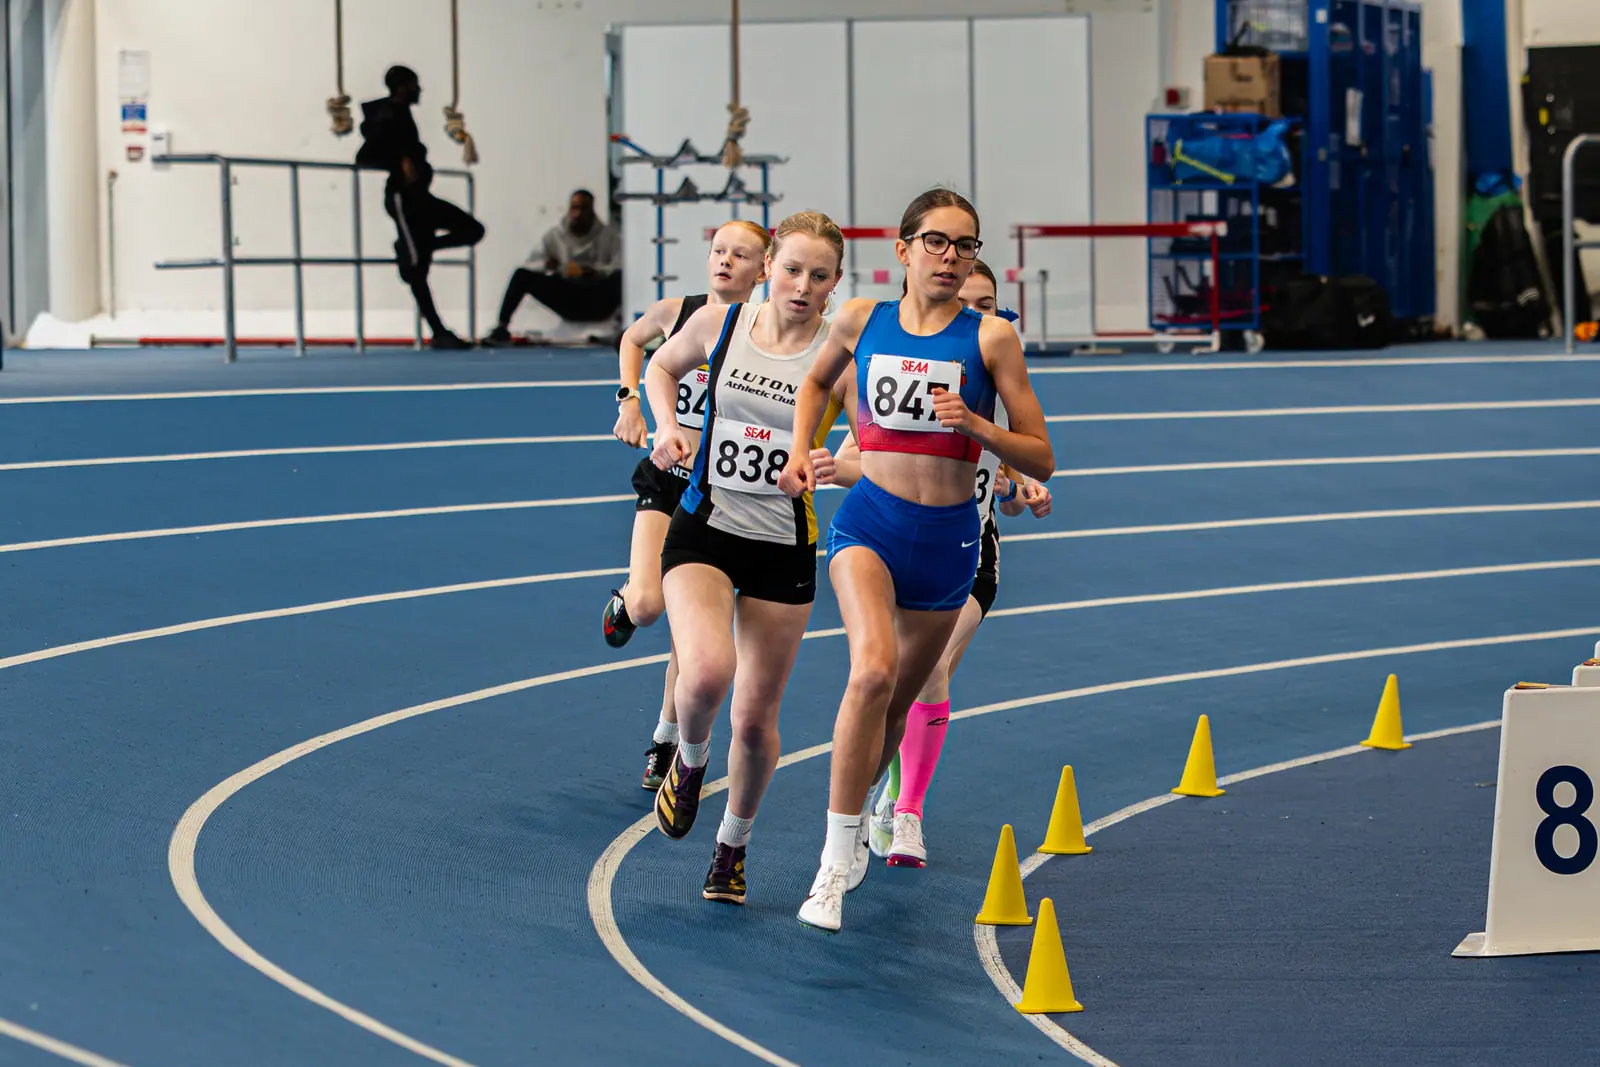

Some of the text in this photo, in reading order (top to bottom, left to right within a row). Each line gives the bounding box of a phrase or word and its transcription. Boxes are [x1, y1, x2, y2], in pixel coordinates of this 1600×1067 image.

[901, 360, 928, 373] SEAA
[724, 380, 796, 407] Athletic Club
[730, 369, 798, 394] LUTON
[744, 426, 771, 440] SEAA
[716, 440, 789, 485] 838
[1534, 764, 1598, 875] 8
